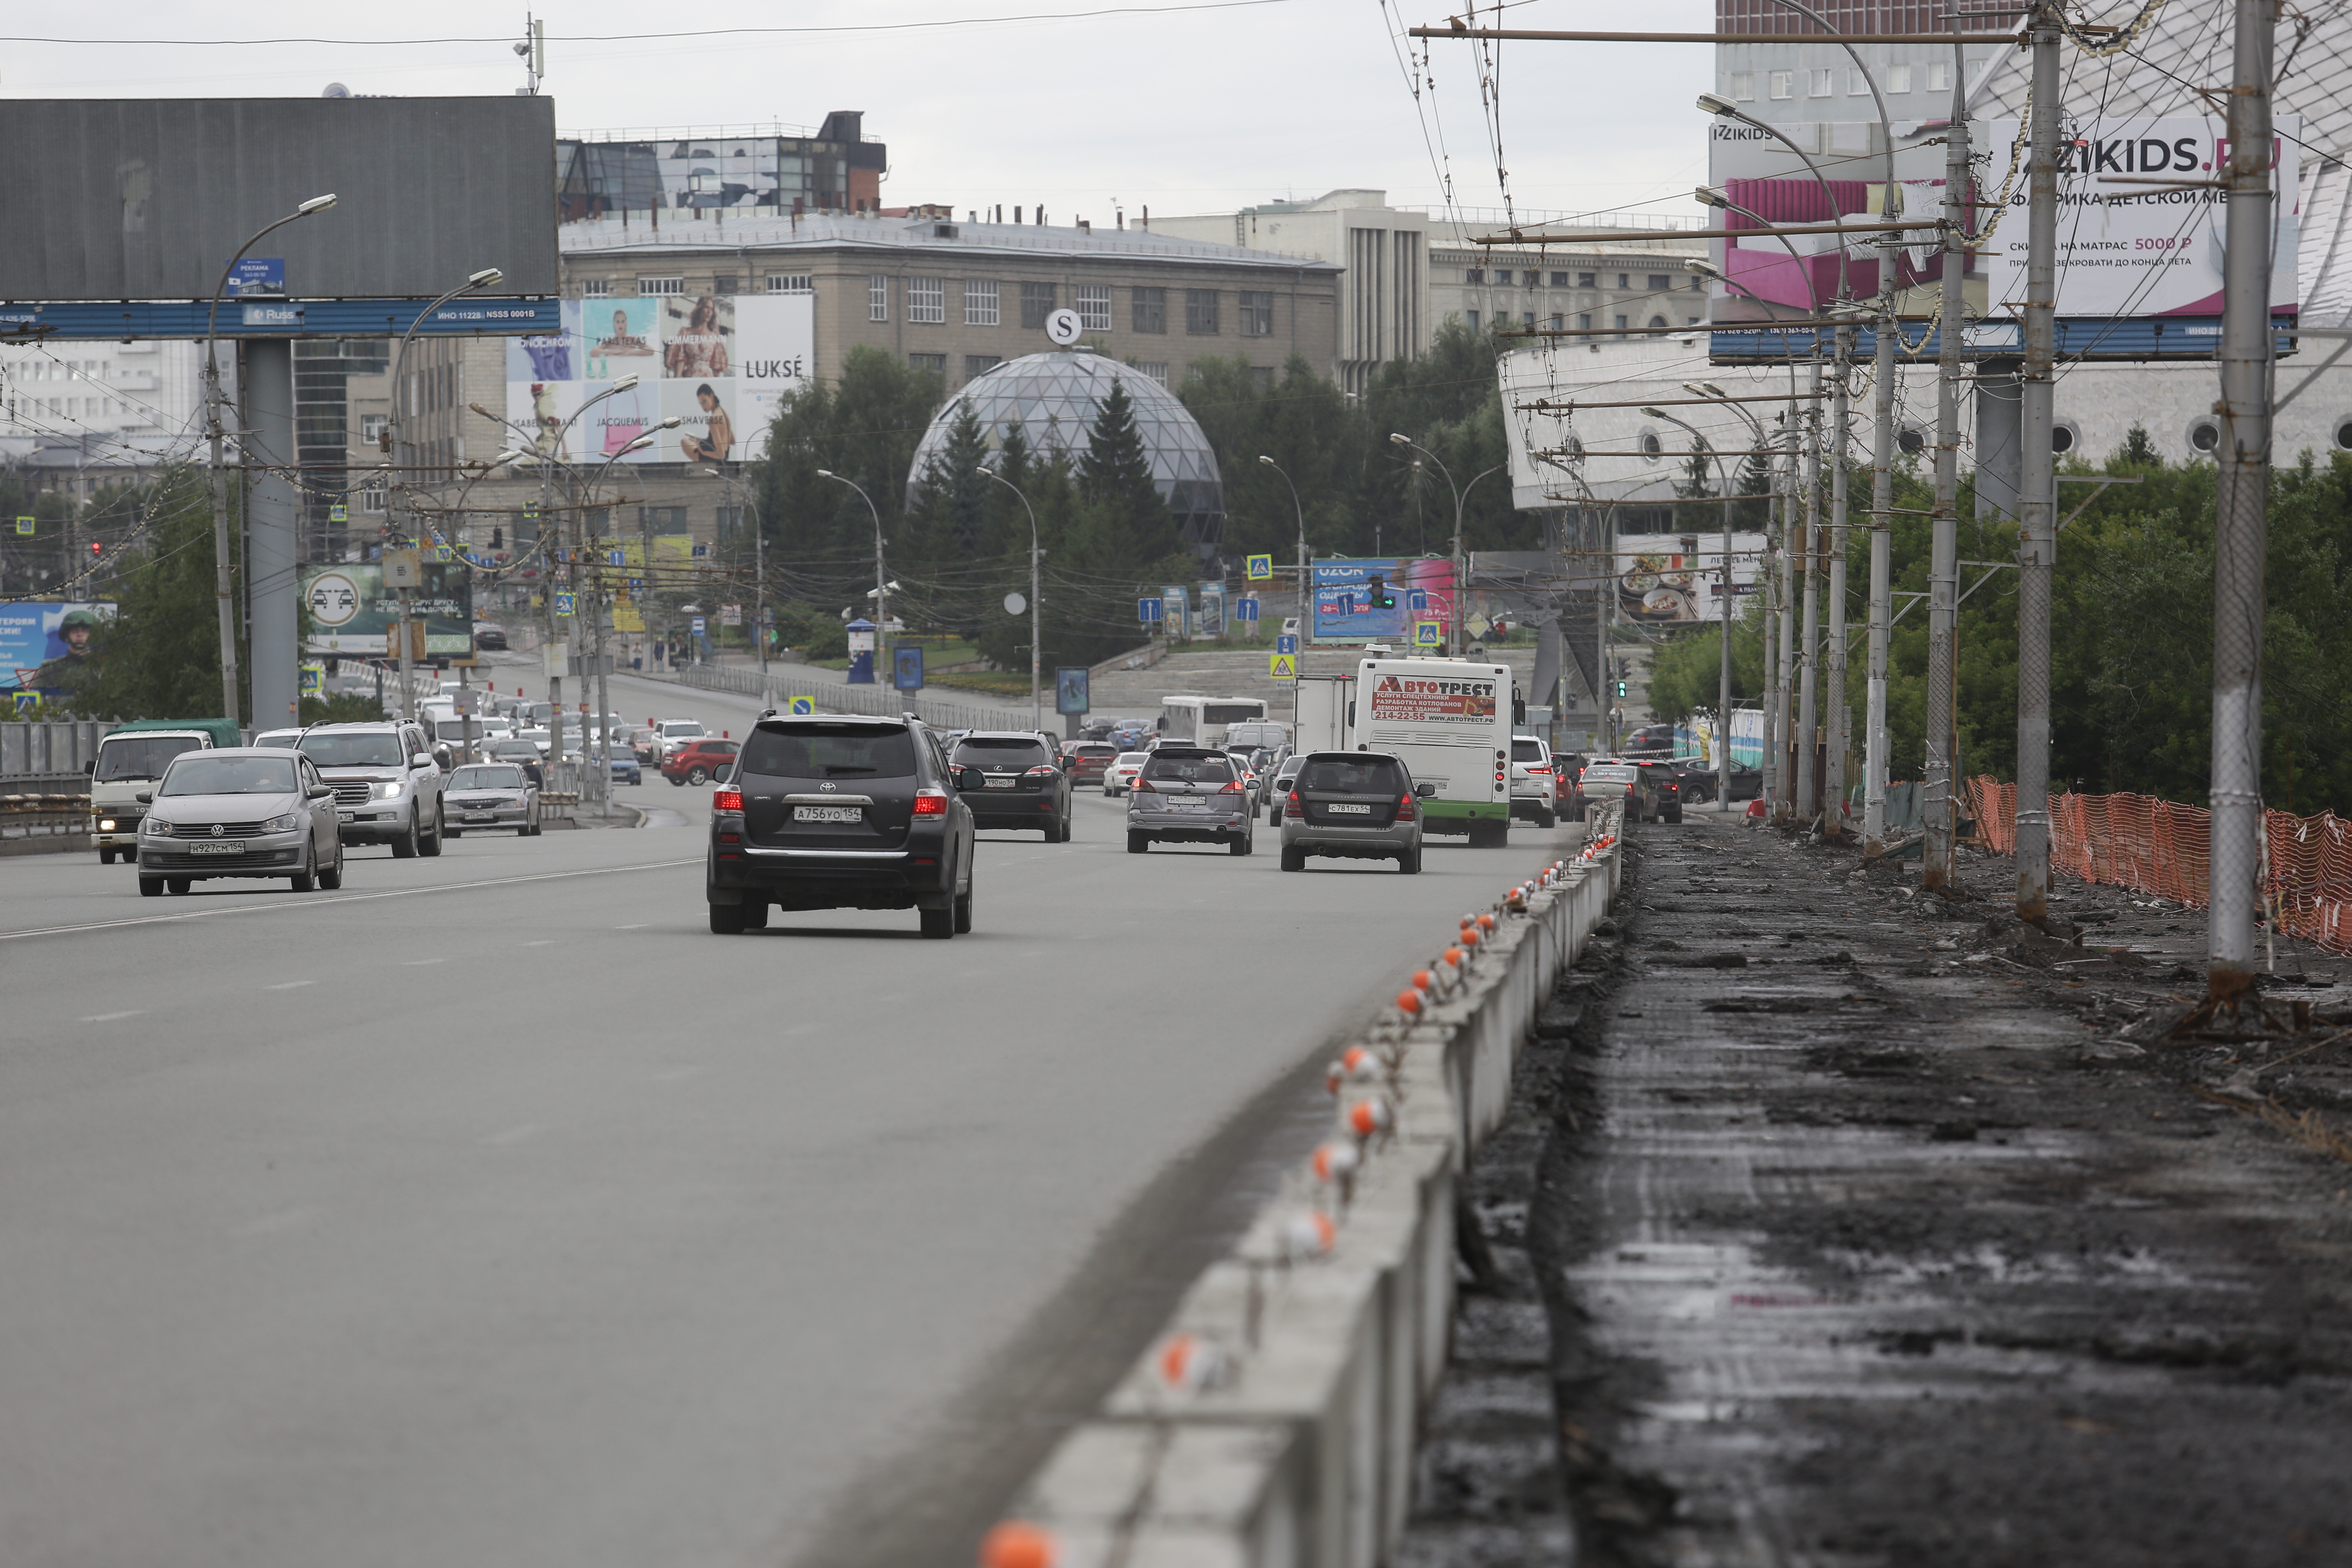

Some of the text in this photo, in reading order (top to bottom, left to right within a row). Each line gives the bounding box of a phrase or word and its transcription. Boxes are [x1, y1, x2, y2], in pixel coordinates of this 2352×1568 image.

[2011, 192, 2102, 207] ФРИКА
[2109, 187, 2196, 207] ДЕТСКОЙ
[2135, 238, 2176, 250] 5000
[2115, 259, 2129, 267] ДО
[2132, 259, 2165, 267] КОНЦА
[2168, 258, 2192, 266] ЛЕТА
[267, 310, 294, 319] Russ
[1057, 315, 1072, 337] S
[596, 336, 646, 346] PARIS TEXAS
[667, 334, 727, 345] ZIMMERMANN
[746, 354, 802, 378] LUKSÉ
[596, 417, 648, 427] JACQUEMUS
[1377, 676, 1493, 696] АВТОТРЕСТ
[1375, 711, 1425, 720] 214-22-55
[843, 808, 859, 817] 154
